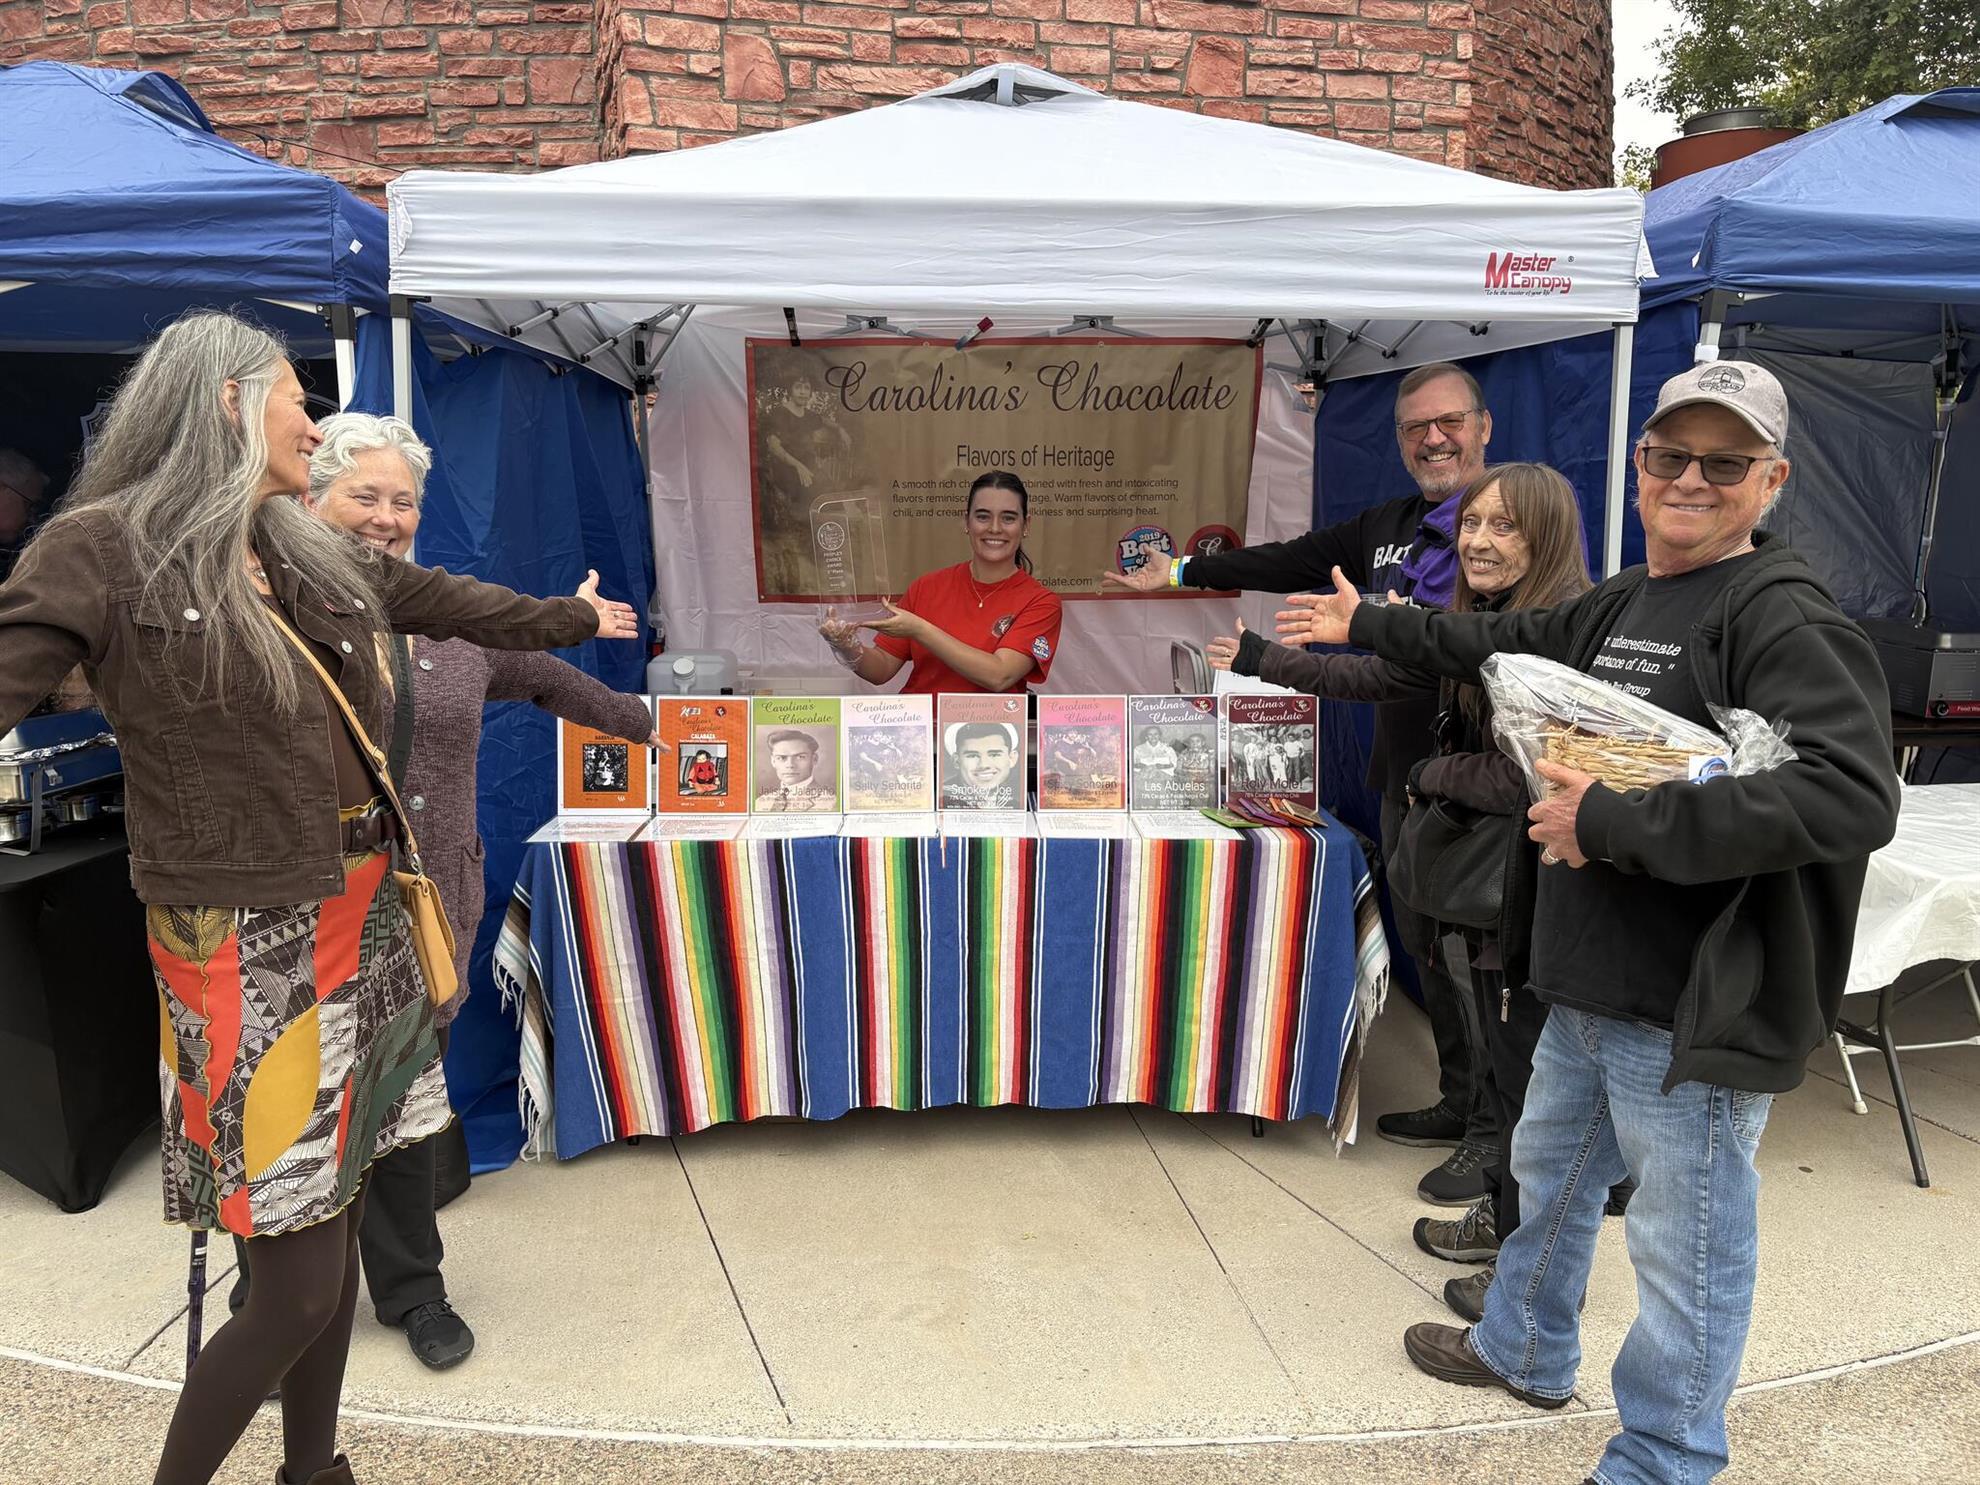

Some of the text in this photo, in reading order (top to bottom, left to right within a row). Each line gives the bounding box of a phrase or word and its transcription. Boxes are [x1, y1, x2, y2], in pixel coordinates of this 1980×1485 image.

[1485, 252, 1556, 288] Master
[1511, 272, 1571, 294] Canopy
[825, 360, 1238, 413] Carolina's Chocolate
[957, 445, 1115, 471] Flavors of Heritage
[892, 480, 900, 488] A
[902, 479, 936, 489] smooth
[940, 479, 956, 488] rich
[1057, 479, 1076, 488] with
[1079, 479, 1102, 488] fresh
[1105, 479, 1121, 488] and
[1125, 479, 1178, 490] intoxicating
[893, 494, 923, 503] flavors
[926, 494, 968, 503] reminisce
[1054, 493, 1082, 502] Warm
[1084, 493, 1116, 502] flavors
[1118, 493, 1127, 502] of
[916, 508, 933, 517] and
[1066, 507, 1084, 516] and
[1087, 506, 1133, 518] surprising
[1136, 506, 1159, 516] heat.
[1138, 532, 1160, 541] 2019
[1611, 635, 1682, 657] underestimate
[1593, 654, 1625, 671] portance
[1625, 657, 1638, 671] of
[1636, 658, 1661, 675] fun.
[1623, 682, 1651, 697] Group
[761, 699, 815, 713] Carolina's
[851, 699, 905, 713] Carolina's
[1131, 698, 1187, 712] Carolina's
[1230, 697, 1286, 710] Carolina's
[778, 712, 833, 724] Chocolate
[868, 711, 922, 724] Chocolate
[1064, 711, 1117, 723] Chocolate
[1149, 711, 1205, 723] Chocolate
[1247, 710, 1304, 722] Chocolate
[951, 784, 1012, 797] Smokey Joe
[1144, 780, 1206, 791] Las Abuelas
